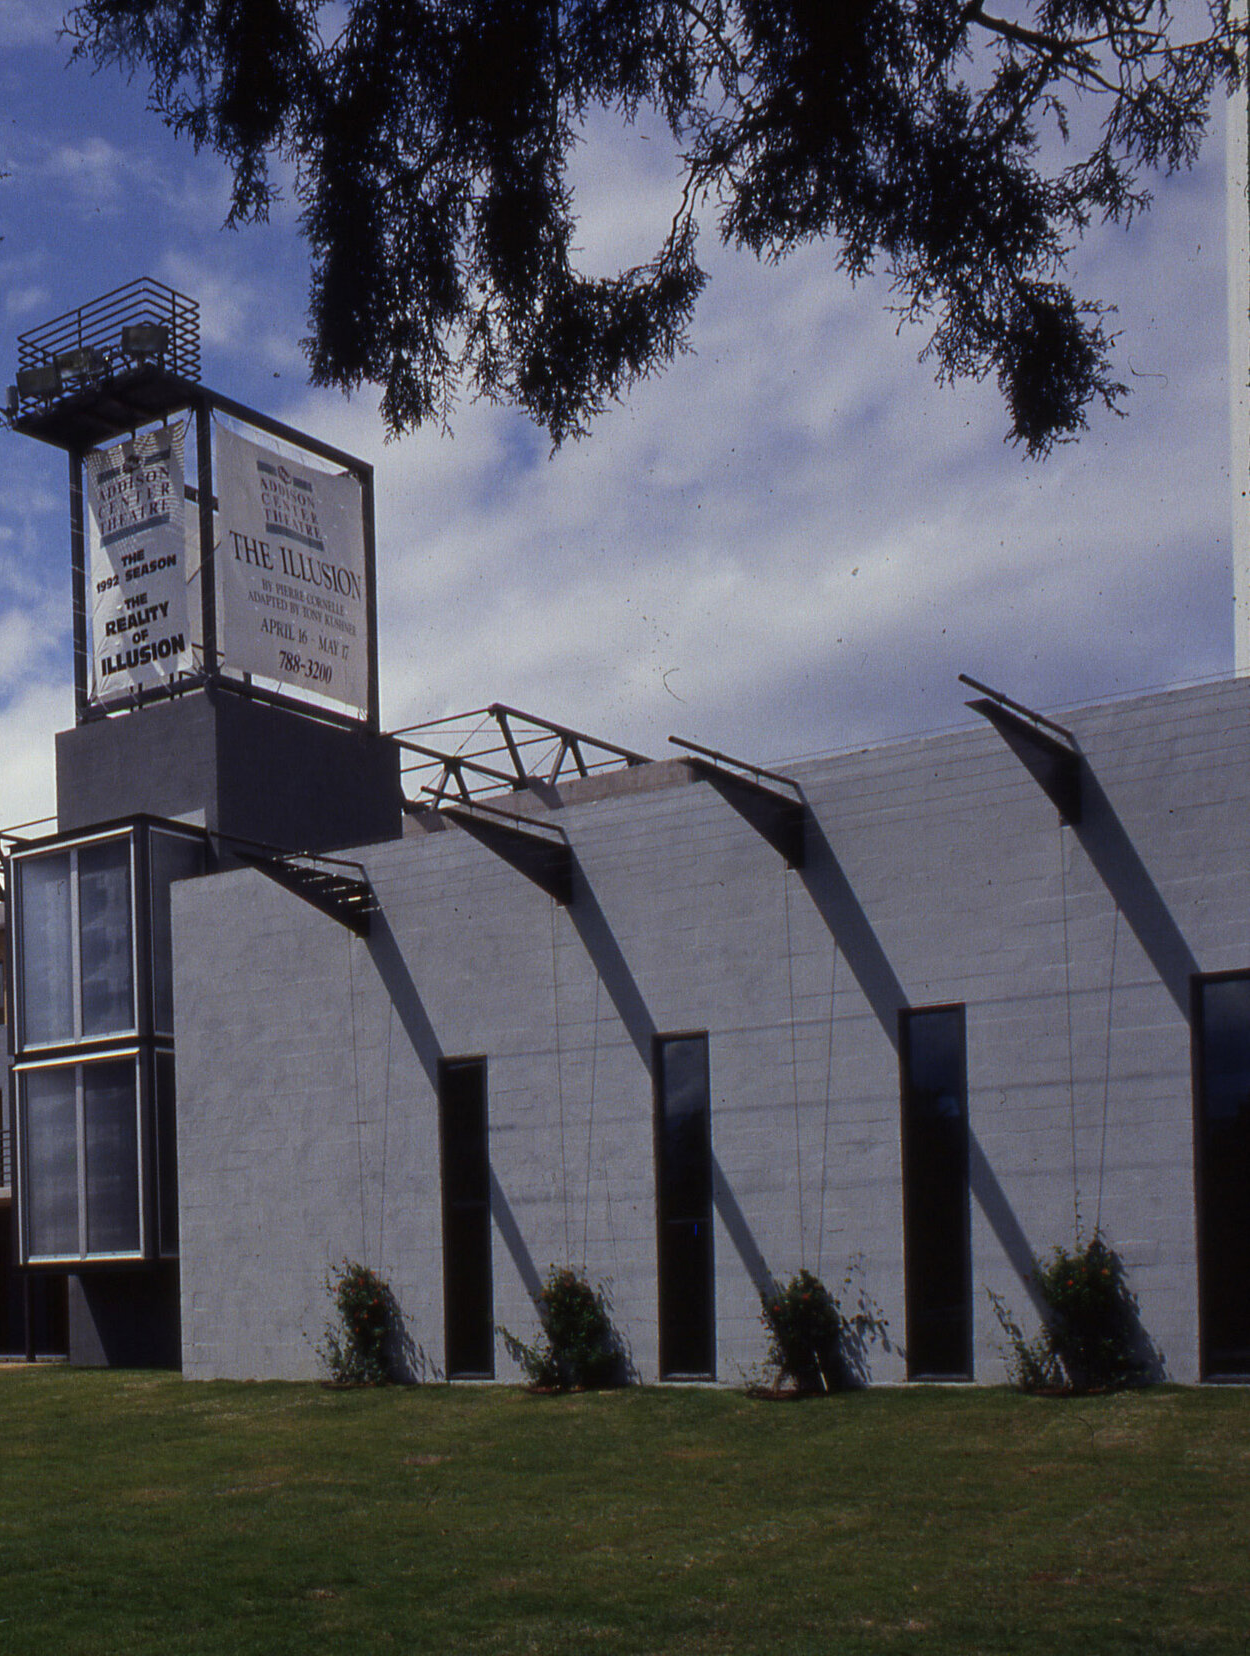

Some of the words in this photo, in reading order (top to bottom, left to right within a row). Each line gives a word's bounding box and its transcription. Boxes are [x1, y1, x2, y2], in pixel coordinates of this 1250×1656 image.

[99, 466, 169, 500] ADDISON
[96, 574, 119, 594] 1992
[125, 553, 177, 582] SEASON
[121, 548, 145, 567] THE
[229, 530, 274, 571] THE
[279, 546, 361, 601] ILLUSION
[124, 592, 148, 610] THE
[248, 591, 288, 611] ADAPTED
[290, 603, 300, 616] BY
[302, 606, 323, 623] TONY
[262, 578, 273, 592] BY
[275, 582, 304, 602] PIERRE
[105, 601, 169, 637] REALITY
[132, 629, 149, 644] OF
[260, 617, 295, 641] APRIL
[298, 628, 308, 644] 16
[318, 634, 339, 657] MAY
[101, 633, 185, 677] ILLUSION
[279, 650, 333, 684] 788-3200
